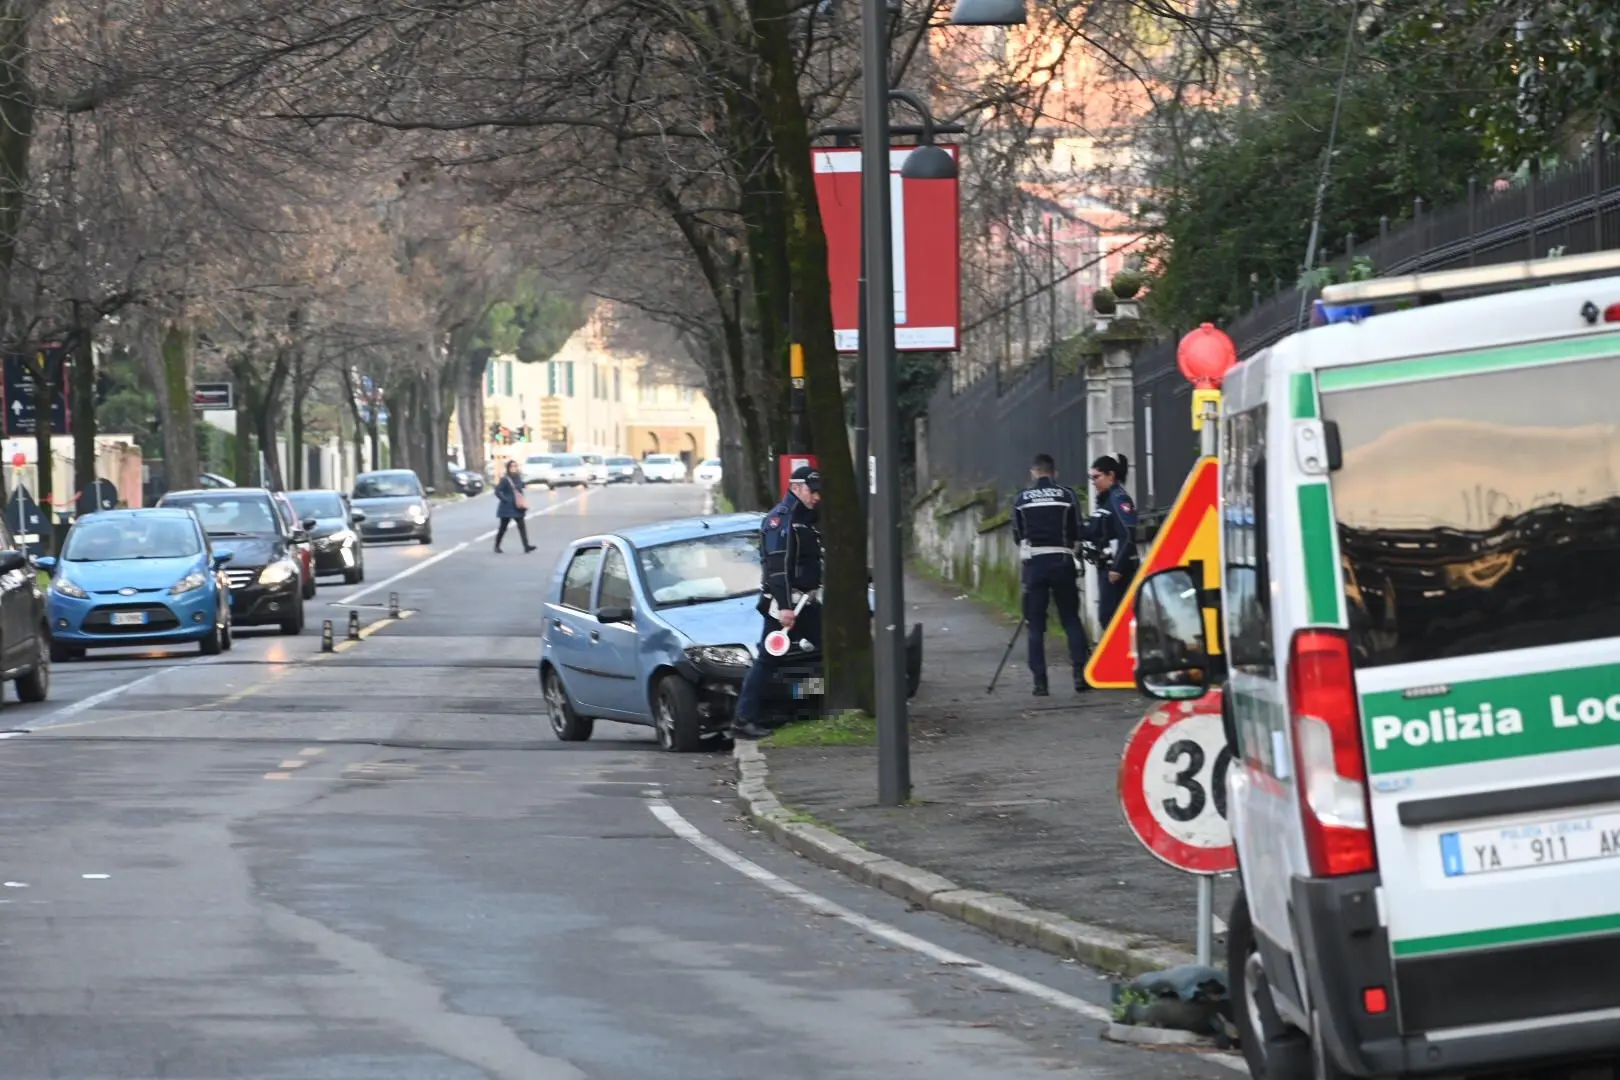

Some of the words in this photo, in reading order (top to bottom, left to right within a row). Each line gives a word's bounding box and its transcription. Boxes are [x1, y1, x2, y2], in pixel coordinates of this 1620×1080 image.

[1371, 703, 1523, 750] Polizia
[1474, 844, 1502, 870] YA
[1530, 836, 1568, 862] 911
